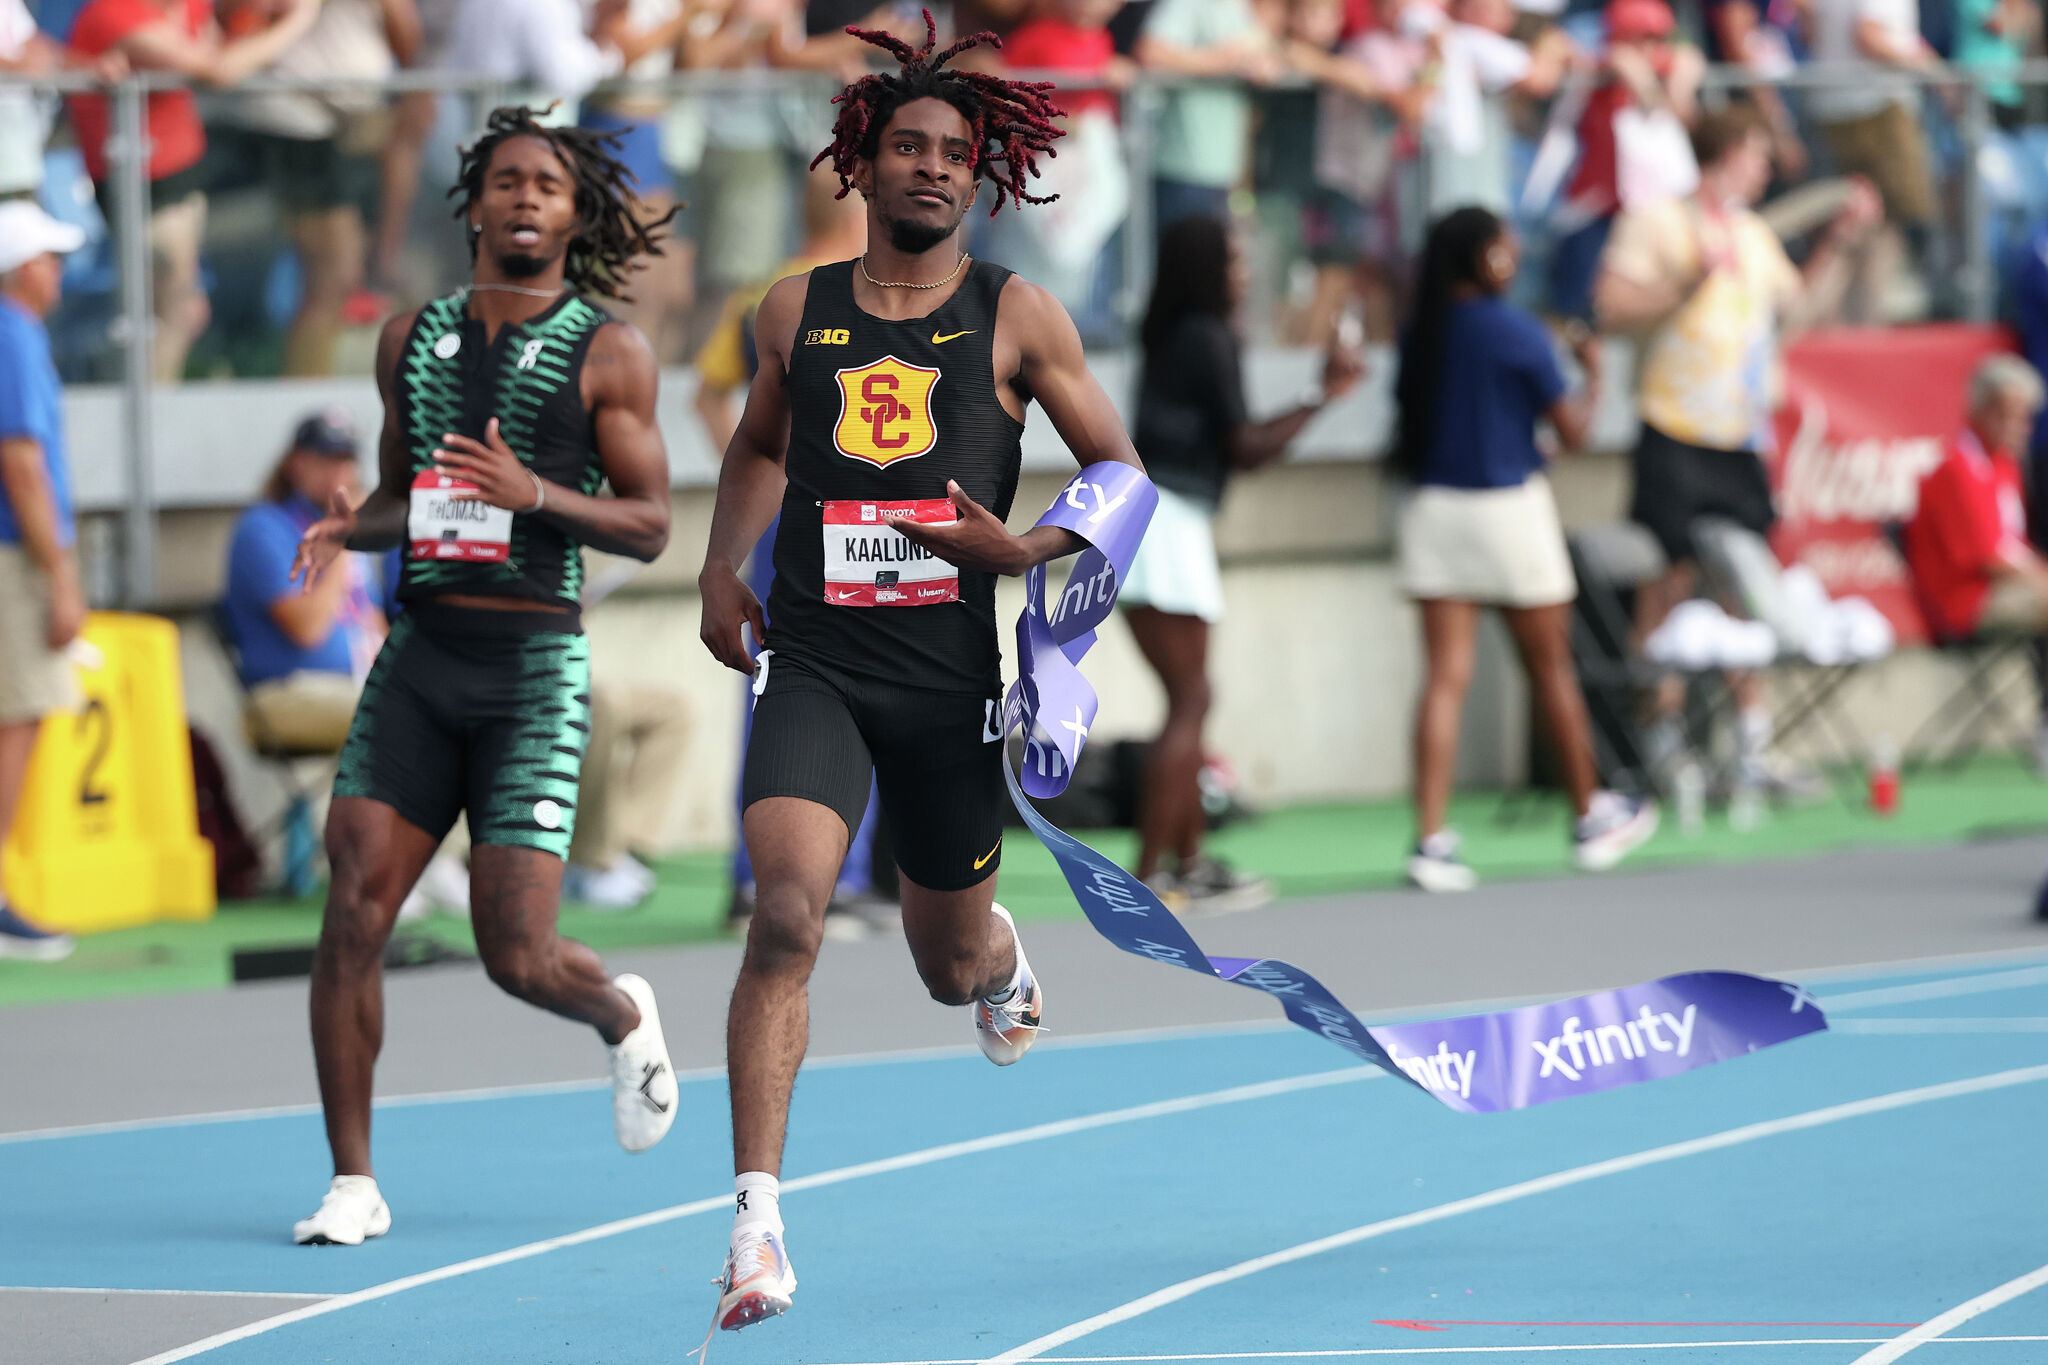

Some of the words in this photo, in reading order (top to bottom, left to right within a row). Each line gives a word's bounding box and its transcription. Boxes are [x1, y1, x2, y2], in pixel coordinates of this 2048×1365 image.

[879, 508, 916, 518] TOYOTA
[74, 696, 114, 805] 2
[1531, 1004, 1697, 1081] xfinity
